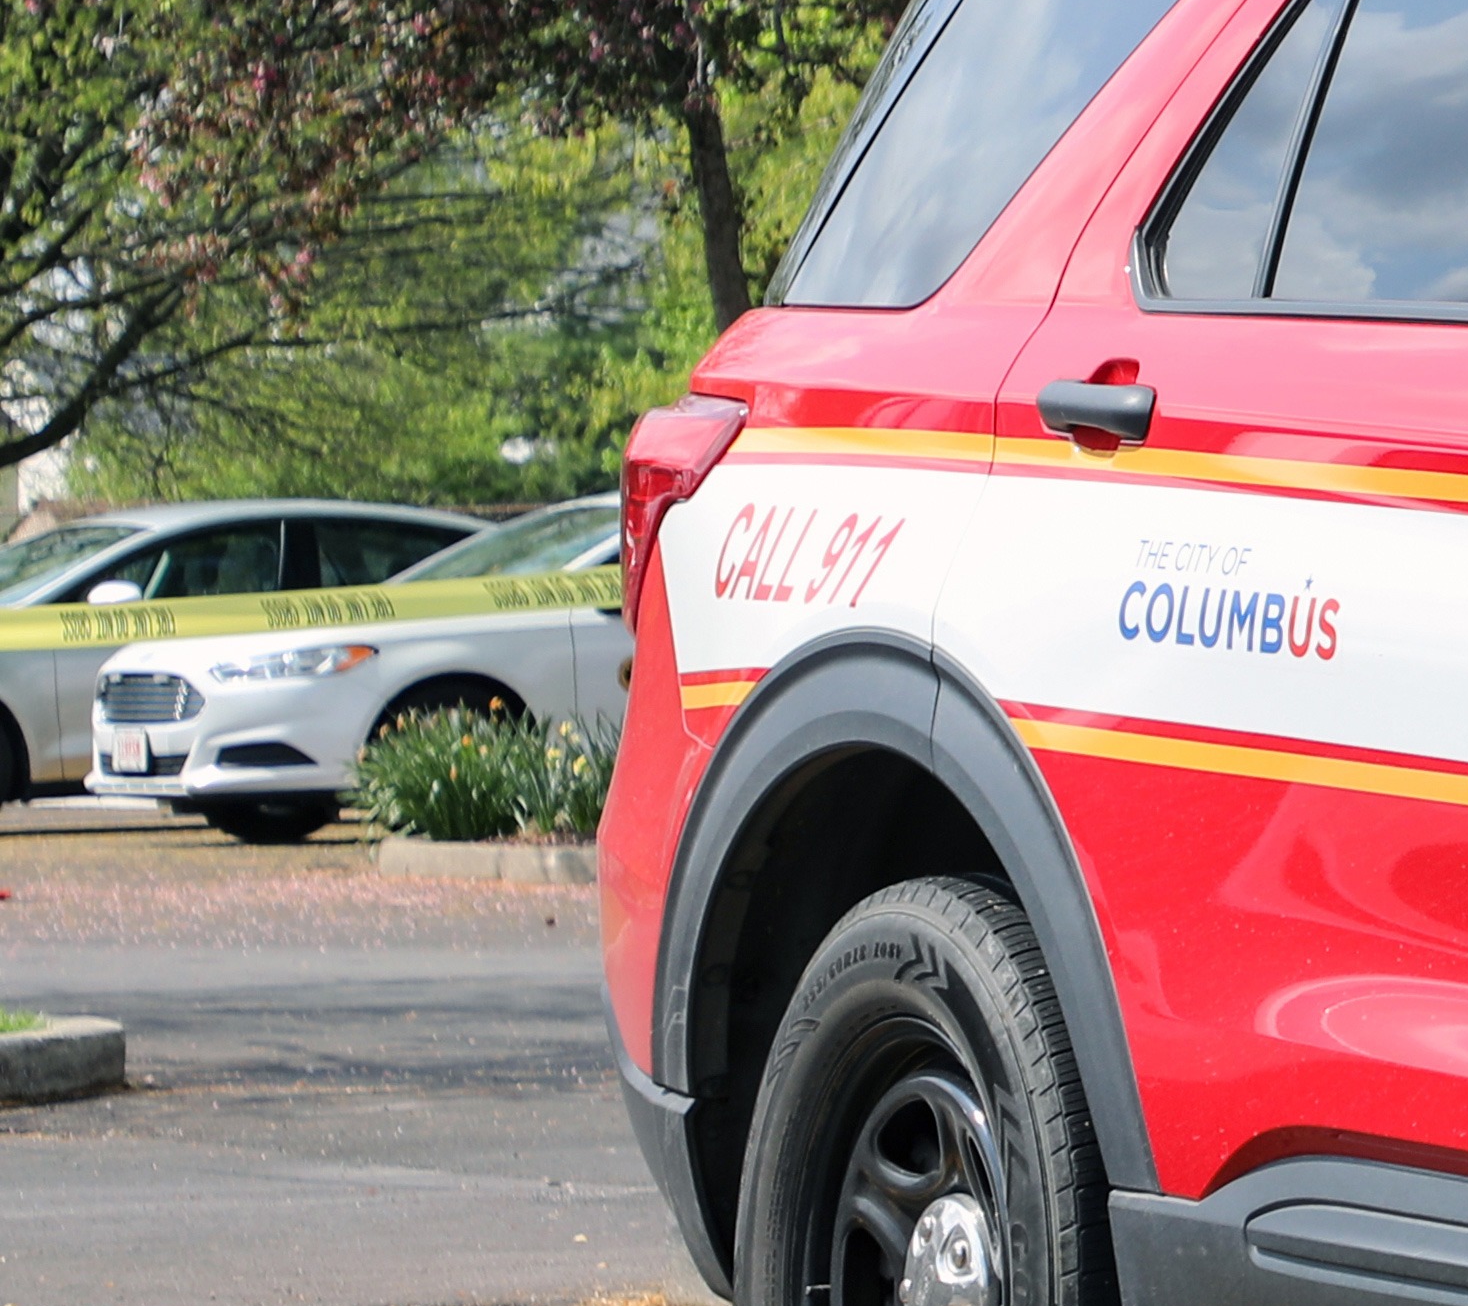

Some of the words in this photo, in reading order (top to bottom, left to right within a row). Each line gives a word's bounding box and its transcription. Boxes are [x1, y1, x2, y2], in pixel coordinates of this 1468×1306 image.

[715, 503, 816, 603] CALL
[804, 513, 905, 609] 911
[1136, 540, 1174, 570] THE
[1175, 543, 1221, 574] CITY
[1221, 547, 1253, 577] OF
[1119, 580, 1341, 661] COLUMBUS
